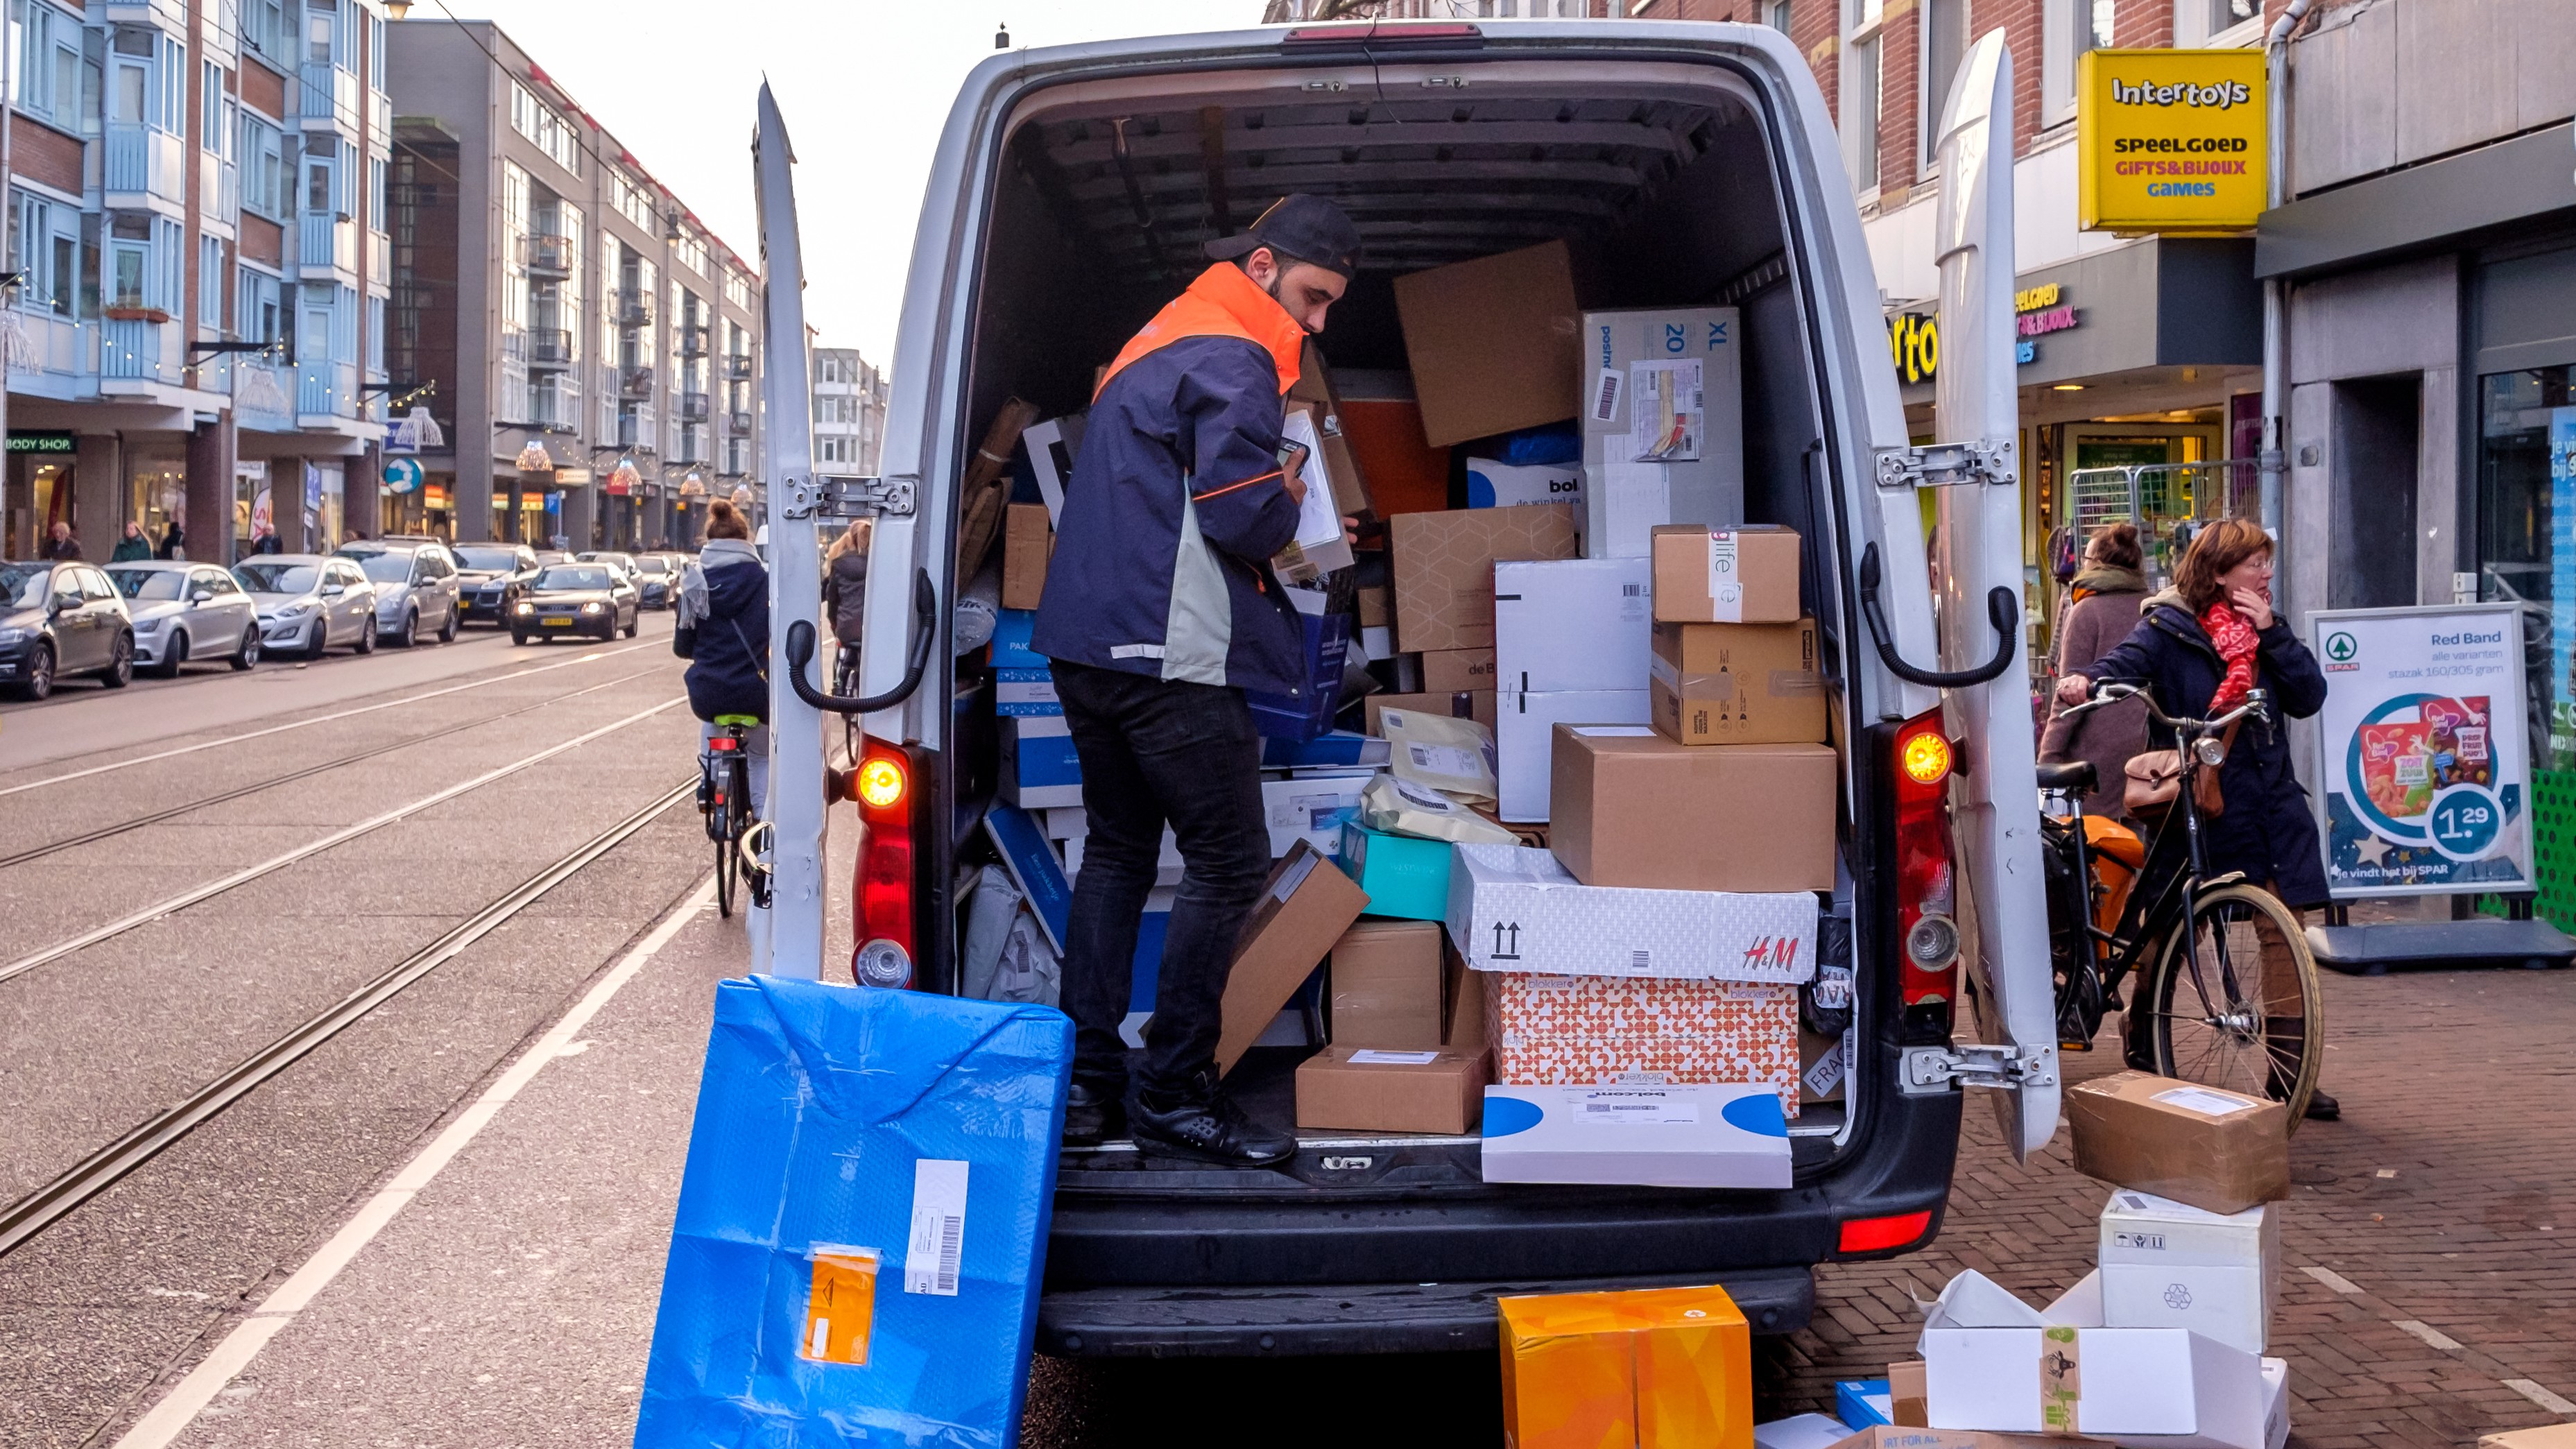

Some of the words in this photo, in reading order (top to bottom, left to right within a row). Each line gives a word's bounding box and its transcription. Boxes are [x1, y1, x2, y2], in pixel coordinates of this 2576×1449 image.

[2112, 78, 2250, 110] Intertoys
[1666, 323, 1685, 352] 20
[1708, 321, 1728, 351] XL
[5, 438, 37, 449] BODY
[2432, 633, 2459, 646] Red
[2464, 631, 2502, 644] Band
[1009, 642, 1029, 651] PAK
[2432, 651, 2450, 661] alle
[2453, 649, 2503, 660] varianten
[2326, 663, 2359, 671] SPAR
[2388, 667, 2423, 679] stazak
[2426, 665, 2473, 678] 160/305
[2475, 665, 2504, 677] gram
[2350, 867, 2380, 879] vindt
[2402, 865, 2418, 881] bij
[2419, 864, 2448, 875] SPAR
[1742, 935, 1799, 973] H&M
[1528, 979, 1566, 988] blokker
[1731, 989, 1769, 1000] blokker
[1625, 1072, 1665, 1082] blokker
[1901, 1435, 1921, 1447] FOR
